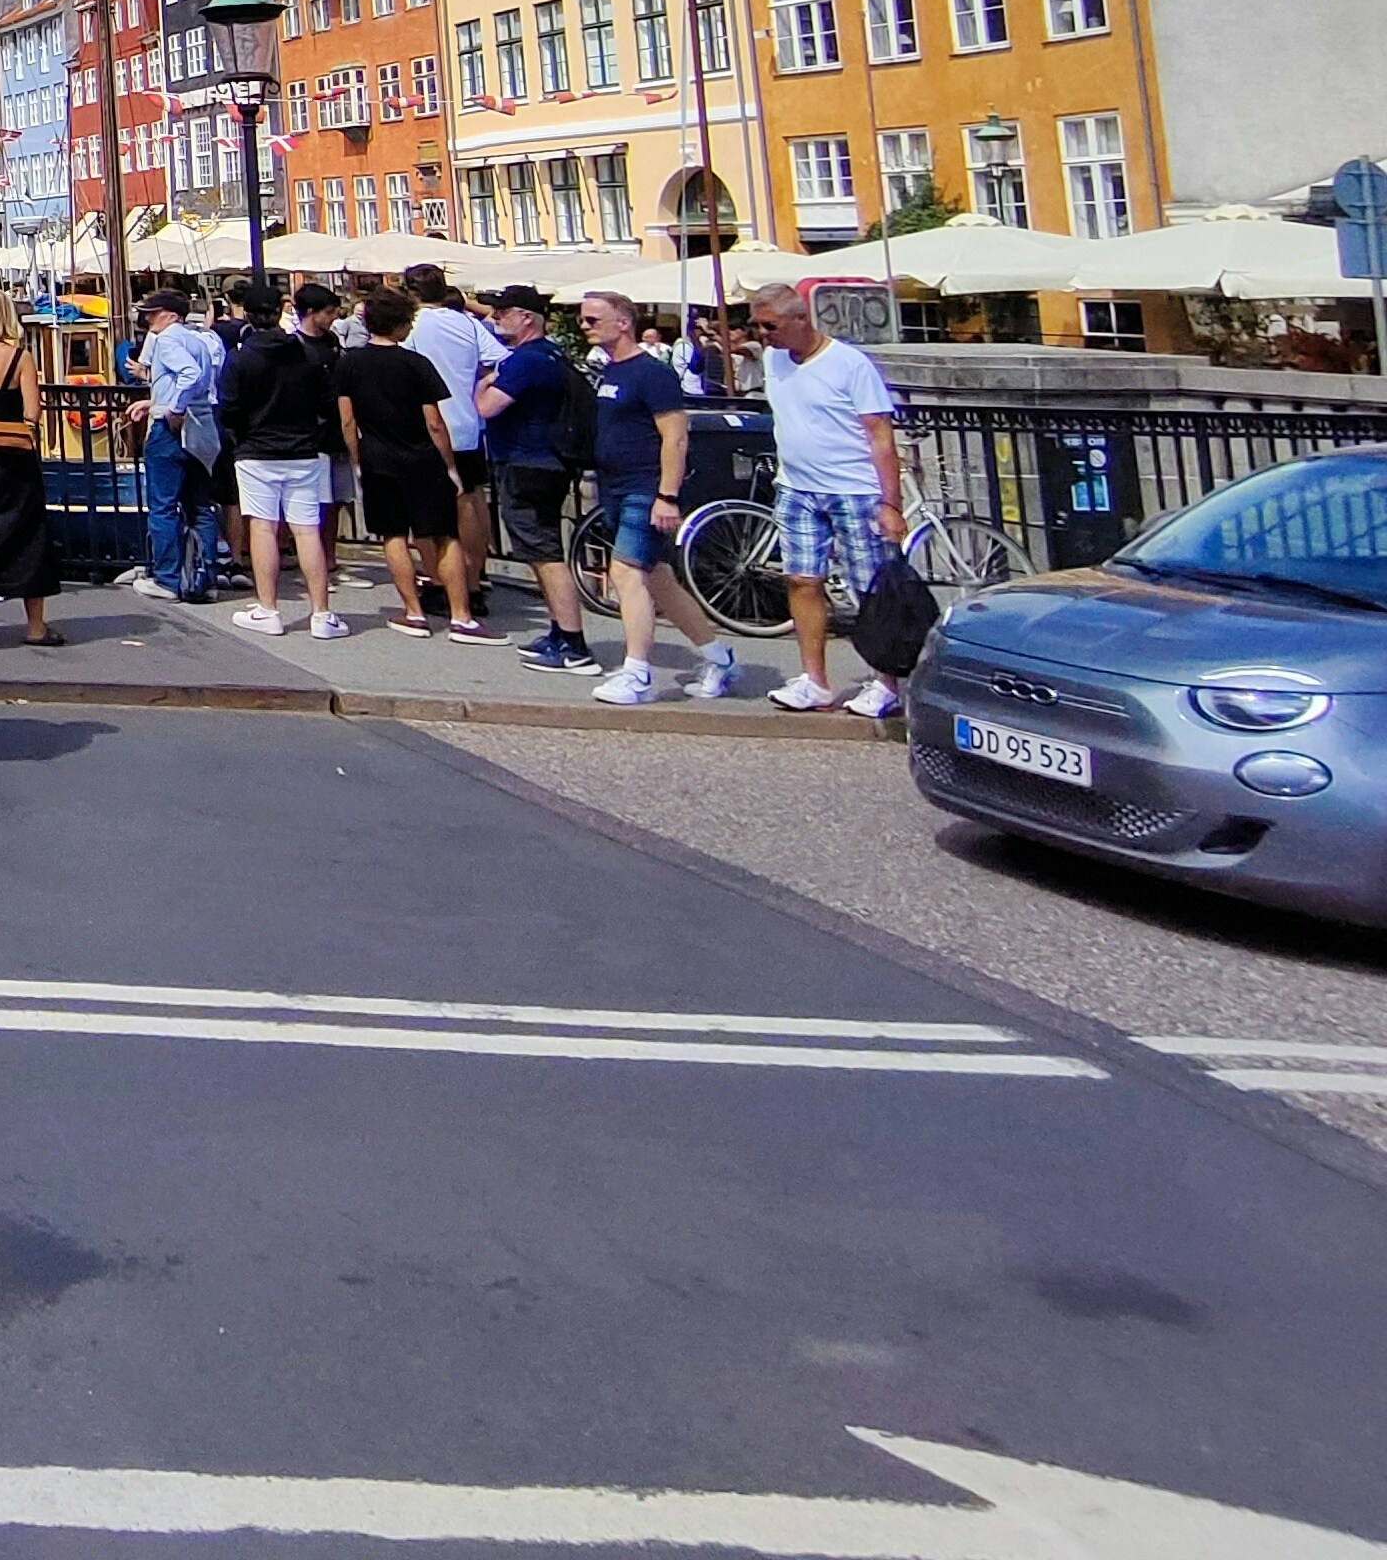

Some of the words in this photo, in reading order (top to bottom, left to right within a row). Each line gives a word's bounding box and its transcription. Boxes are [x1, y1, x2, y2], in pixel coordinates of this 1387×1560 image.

[991, 670, 1059, 704] 500
[970, 726, 1000, 754] DD
[1007, 736, 1032, 763] 95
[1040, 744, 1083, 776] 523
